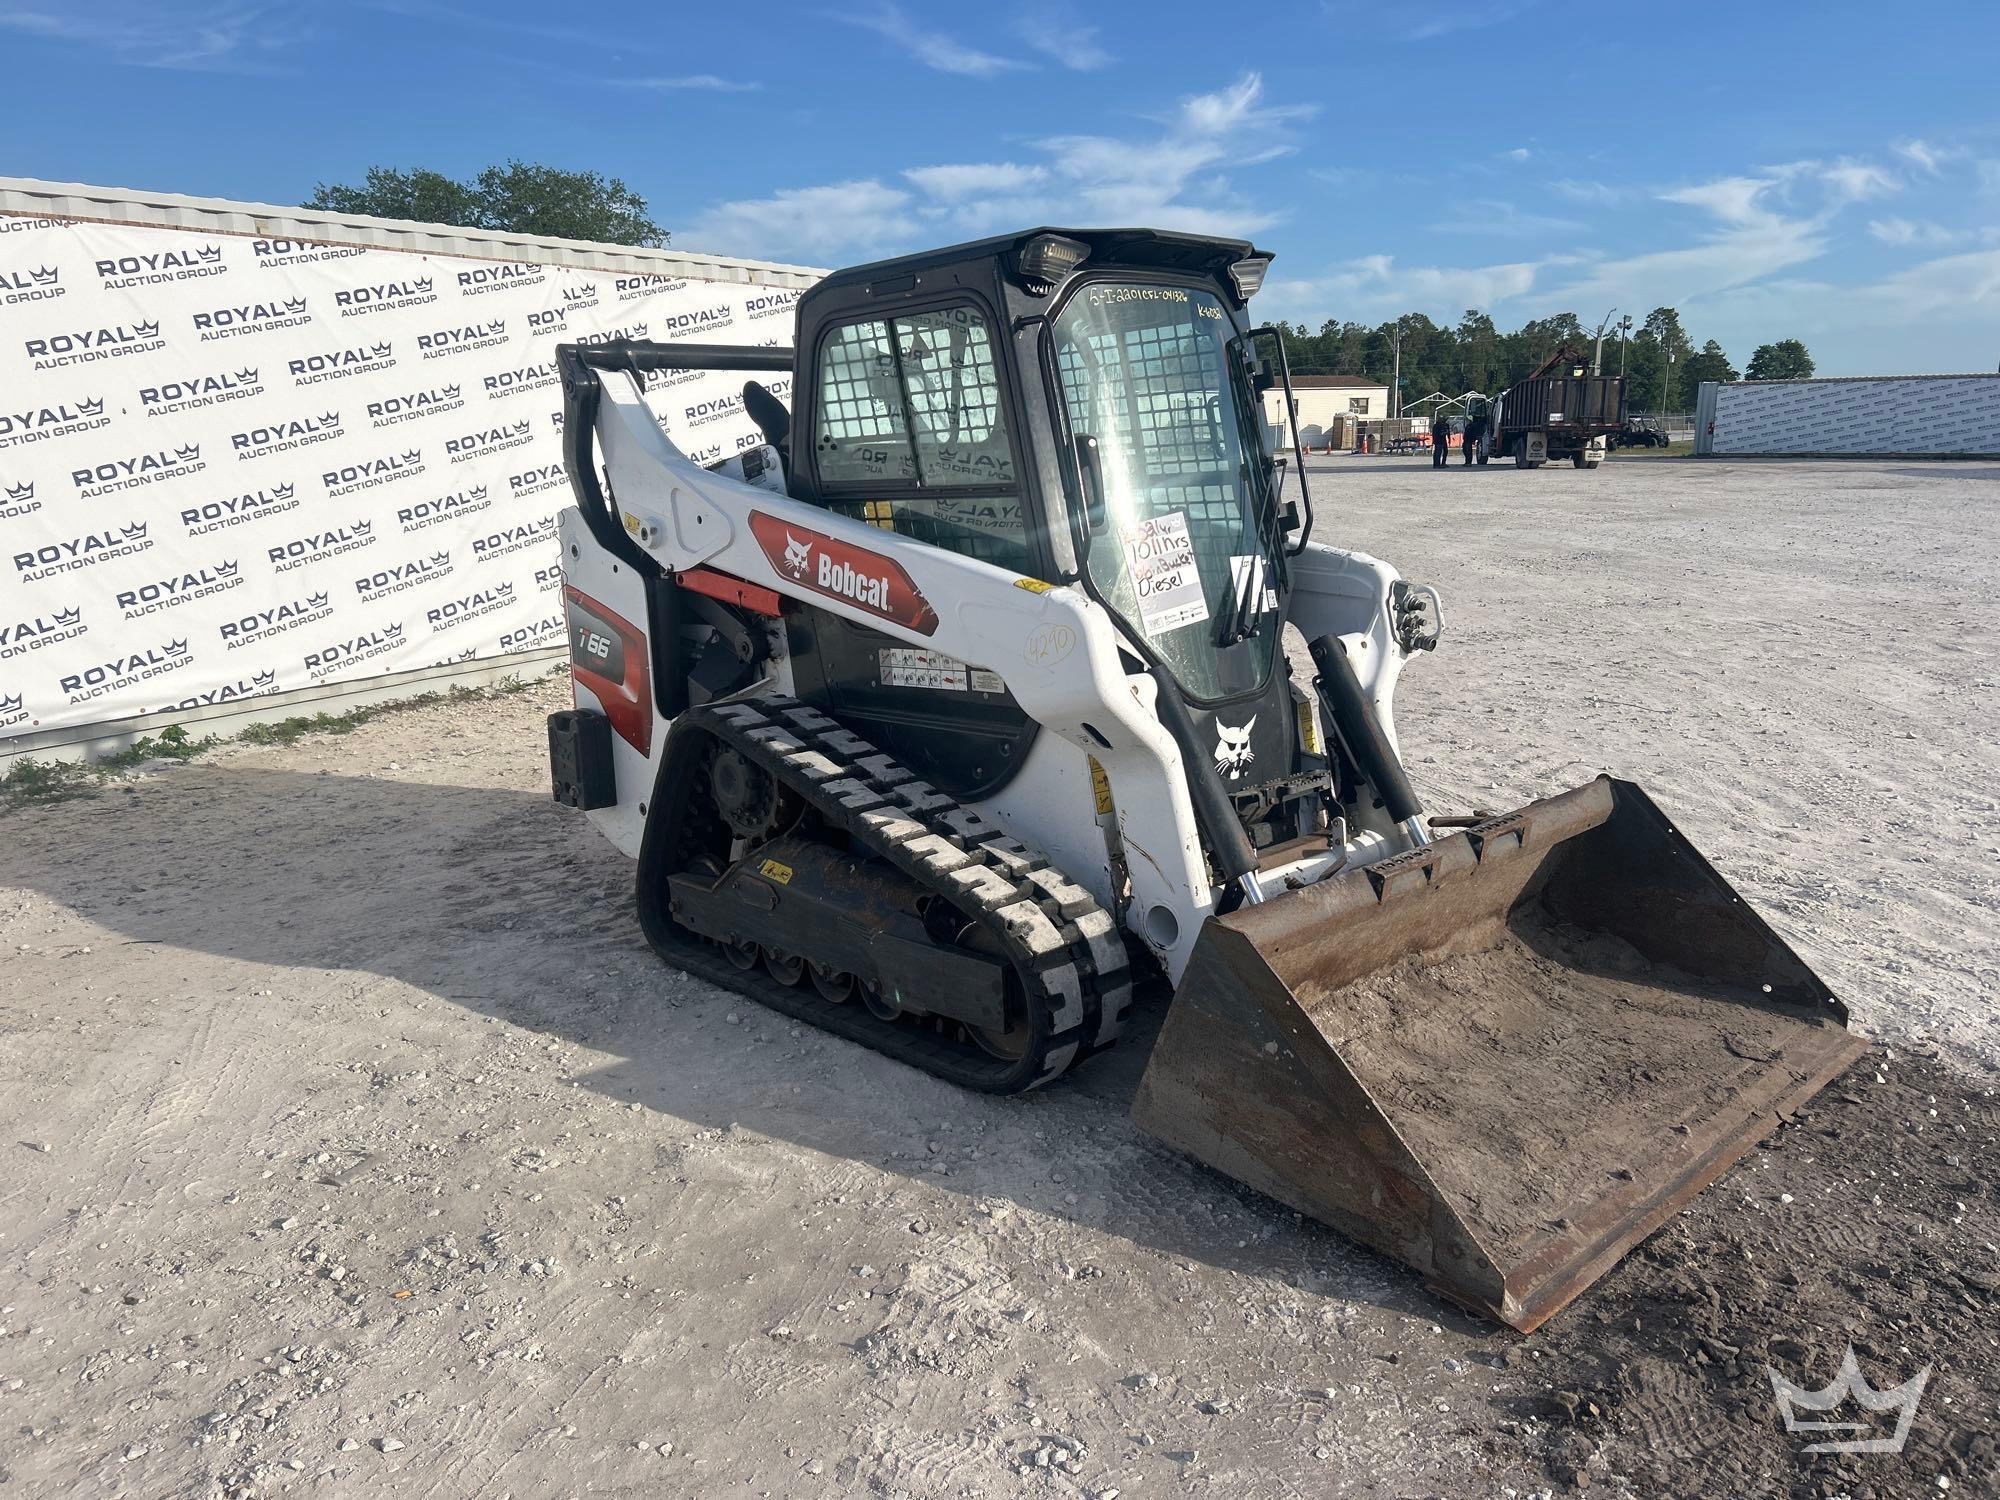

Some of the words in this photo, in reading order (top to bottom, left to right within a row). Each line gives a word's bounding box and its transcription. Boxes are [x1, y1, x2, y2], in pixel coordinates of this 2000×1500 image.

[0, 220, 65, 233] UCTION
[96, 250, 199, 277] ROYAL
[260, 254, 319, 268] AUCTION
[321, 248, 367, 260] GROUP
[104, 273, 173, 290] AUCTION
[177, 265, 227, 280] GROUP
[458, 264, 526, 286] ROYAL
[462, 283, 509, 296] AUCTION
[511, 276, 545, 287] GROUP
[6, 288, 66, 304] GROUP
[335, 282, 414, 306] ROYAL
[567, 300, 599, 311] GROUP
[619, 287, 657, 301] AUCTION
[658, 282, 687, 293] GROUP
[746, 293, 791, 311] ROYAL
[193, 303, 285, 329] ROYAL
[341, 302, 395, 317] AUCTION
[398, 295, 437, 308] GROUP
[527, 308, 566, 327] ROY
[666, 310, 718, 330] ROYAL
[749, 308, 779, 320] AUCTION
[781, 305, 795, 313] GRO
[25, 327, 135, 357] ROYAL
[200, 324, 262, 342] AUCTION
[265, 316, 312, 330] GROUP
[417, 324, 488, 350] ROYAL
[532, 323, 567, 337] AUCTIO
[670, 327, 705, 339] AUCTION
[707, 319, 733, 331] GROUP
[34, 348, 108, 370] AUCTION
[111, 341, 166, 357] GROUP
[288, 348, 373, 375] ROYAL
[423, 345, 471, 360] AUCTION
[473, 336, 509, 350] GROUP
[295, 369, 352, 387] AUCTION
[354, 359, 397, 374] GROUP
[484, 365, 550, 390] ROYAL
[645, 380, 675, 392] UCTION
[677, 372, 705, 384] GROUP
[140, 375, 237, 405] ROYAL
[147, 397, 213, 417] AUCTION
[216, 387, 264, 402] GROUP
[367, 390, 443, 418] ROYAL
[488, 383, 533, 400] AUCTION
[0, 406, 78, 434] OYAL
[373, 410, 425, 428] AUCTION
[427, 400, 464, 415] GROUP
[685, 397, 735, 419] ROYAL
[689, 413, 724, 428] AUCTION
[725, 407, 745, 418] GROU
[0, 430, 50, 448] CTION
[53, 418, 111, 436] GROUP
[231, 419, 320, 449] ROYAL
[238, 440, 298, 461] AUCTION
[300, 429, 345, 446] GROUP
[446, 427, 515, 454] ROYAL
[736, 433, 763, 449] ROY
[450, 446, 497, 464] AUCTION
[499, 436, 533, 450] GROUP
[72, 451, 177, 487] ROYAL
[81, 475, 152, 499] AUCTION
[155, 462, 206, 481] GROUP
[323, 456, 402, 487] ROYAL
[329, 478, 384, 498] AUCTION
[385, 466, 426, 482] GROUP
[509, 464, 565, 489] ROYA
[514, 482, 557, 499] AUCTION
[181, 491, 274, 525] ROYAL
[189, 514, 252, 537] AUCTION
[253, 500, 300, 518] GROUP
[398, 492, 471, 524] ROYAL
[403, 512, 453, 533] AUCTION
[454, 501, 491, 517] GROUP
[13, 531, 123, 572] ROYAL
[268, 529, 352, 563] ROYAL
[473, 524, 539, 554] ROYAL
[478, 543, 523, 563] AUCTION
[524, 532, 558, 547] GROUP
[22, 554, 98, 584] AUCTION
[98, 540, 154, 562] GROUP
[275, 549, 332, 574] AUCTION
[334, 536, 376, 554] GROUP
[116, 570, 217, 609] ROYAL
[356, 559, 433, 593] ROYAL
[361, 579, 414, 603] AUCTION
[415, 567, 454, 585] GROUP
[818, 553, 889, 611] Bobcat
[1139, 571, 1182, 597] Diesel
[124, 594, 192, 620] AUCTION
[195, 578, 244, 599] GROUP
[427, 590, 496, 624] ROYAL
[220, 602, 309, 639] ROYAL
[227, 624, 287, 650] AUCTION
[289, 608, 334, 629] GROUP
[433, 609, 479, 633] AUCTION
[481, 597, 517, 614] GROUP
[31, 625, 88, 649] GROUP
[500, 616, 563, 649] ROYAL
[504, 636, 548, 655] AUCTION
[550, 627, 568, 639] GRO
[579, 627, 611, 659] T66
[304, 632, 384, 670] ROYAL
[310, 654, 365, 680] AUCTION
[366, 638, 407, 658] GROUP
[60, 650, 165, 694] ROYAL
[69, 675, 139, 705] AUCTION
[142, 656, 194, 680] GROUP
